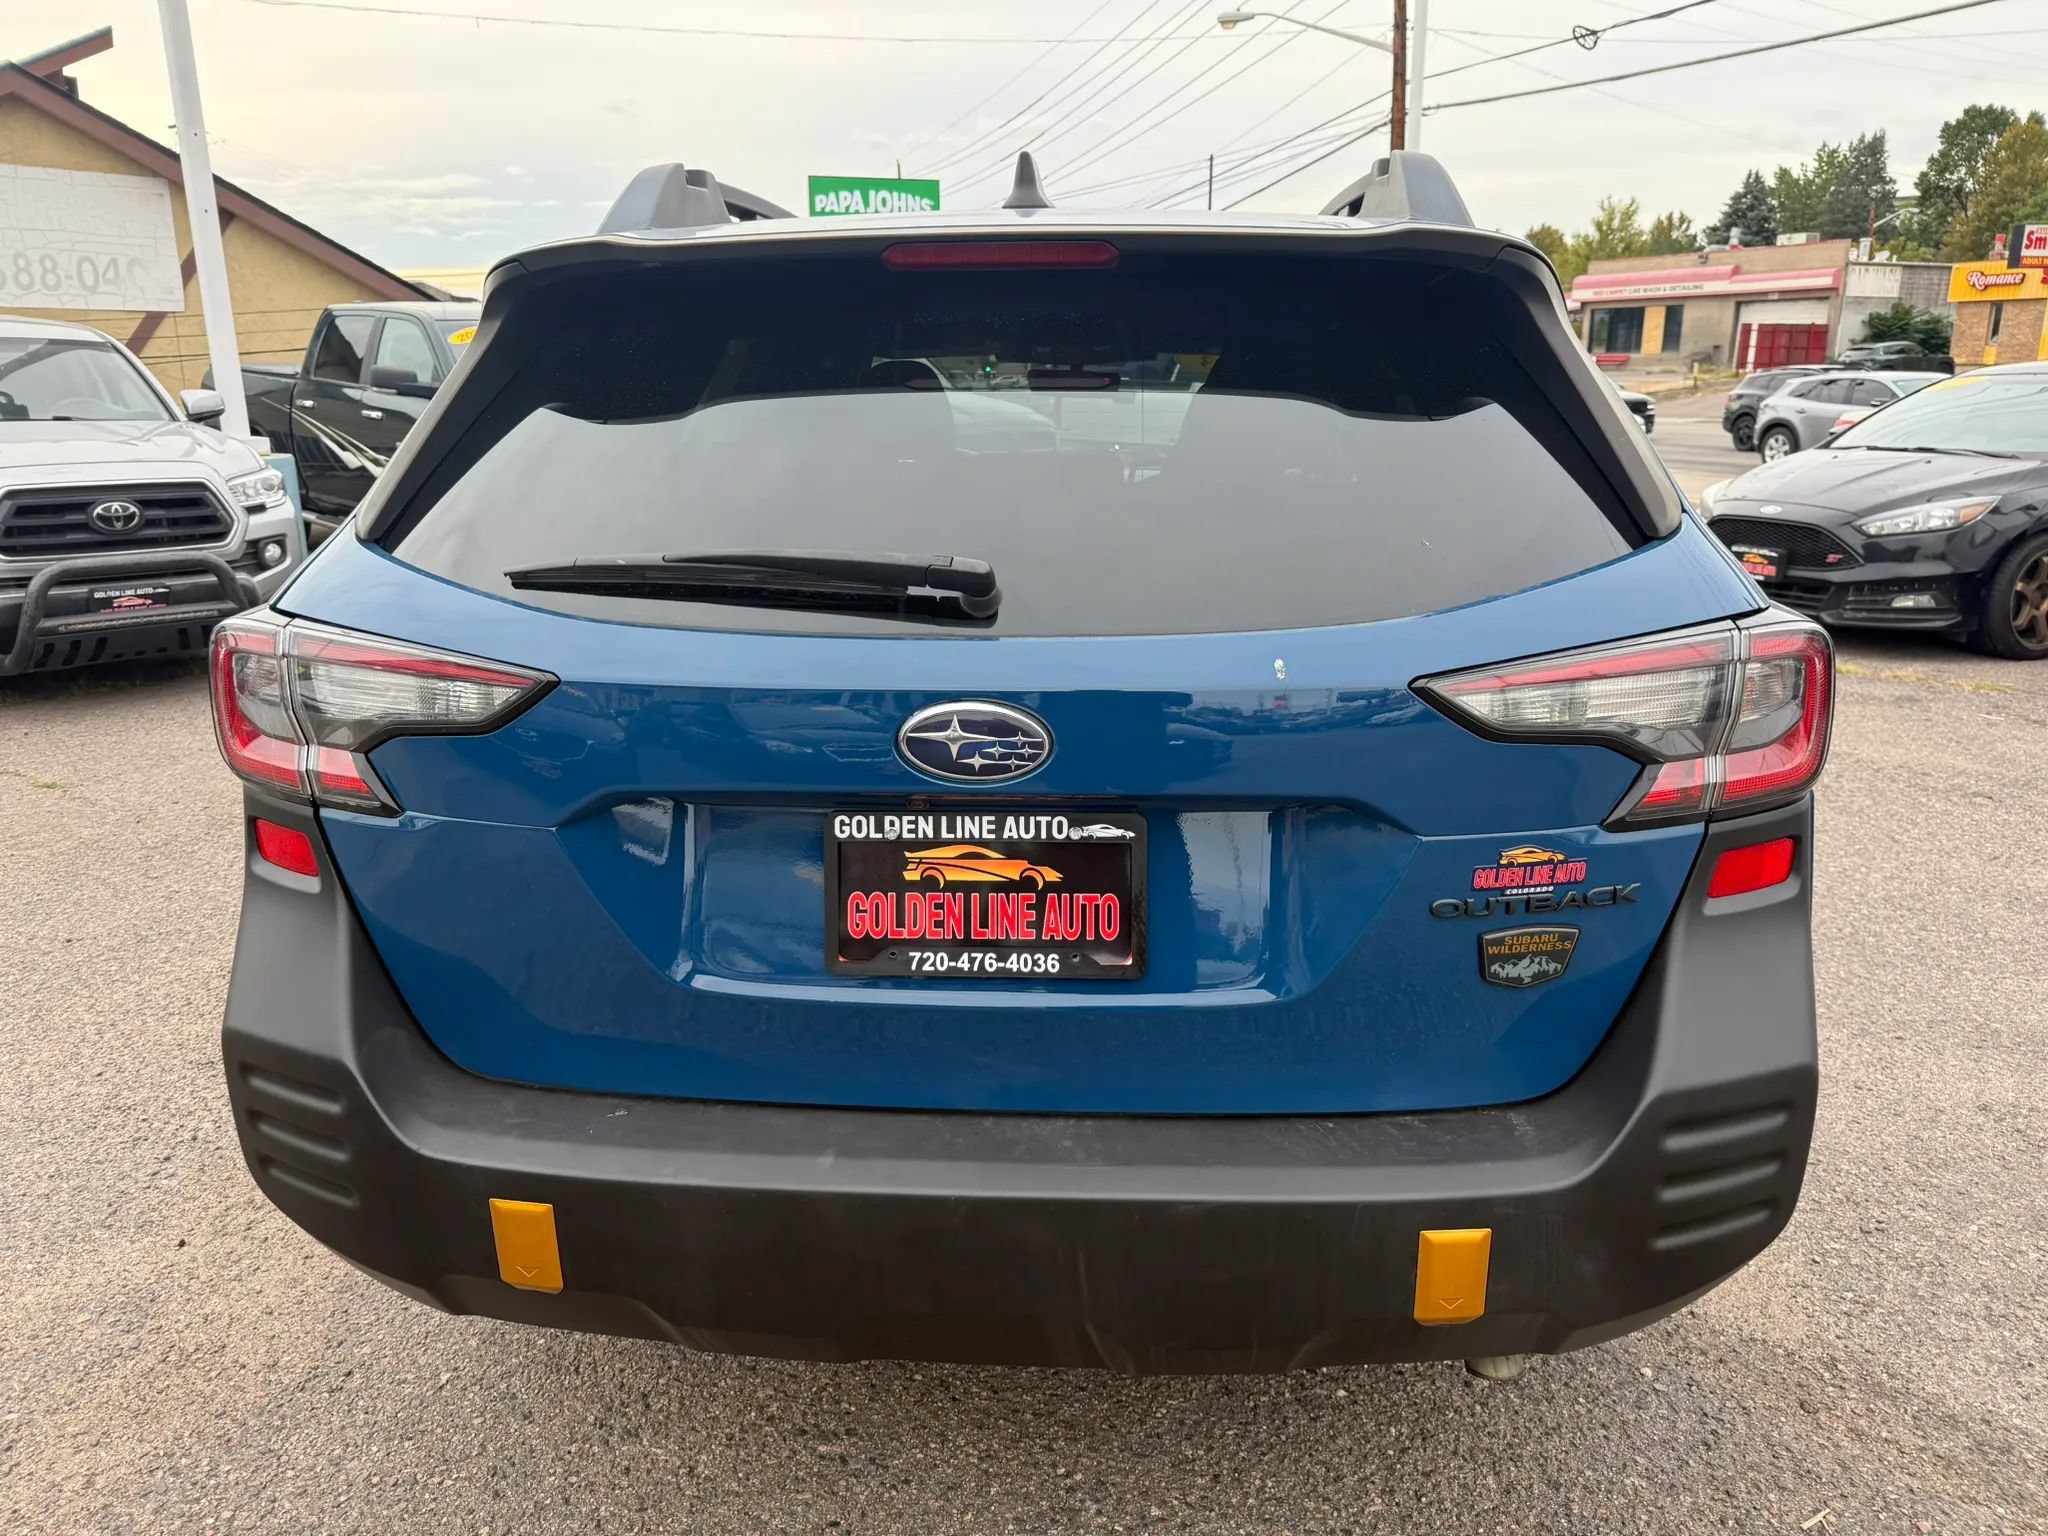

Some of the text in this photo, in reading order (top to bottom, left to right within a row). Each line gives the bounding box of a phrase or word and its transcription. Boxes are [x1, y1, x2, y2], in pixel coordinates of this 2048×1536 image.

[1967, 271, 2025, 291] Romance
[834, 815, 1069, 840] GOLDEN LINE AUTO
[1473, 861, 1588, 890] GOLDEN LINE AUTO
[1429, 882, 1641, 919] OUTBACK
[1504, 885, 1555, 896] COLORADO
[847, 891, 1120, 942] GOLDEN LINE AUTO
[1487, 940, 1573, 955] WILDERNESS
[1504, 933, 1560, 946] SUBARU
[909, 951, 1060, 974] 720-476-4036
